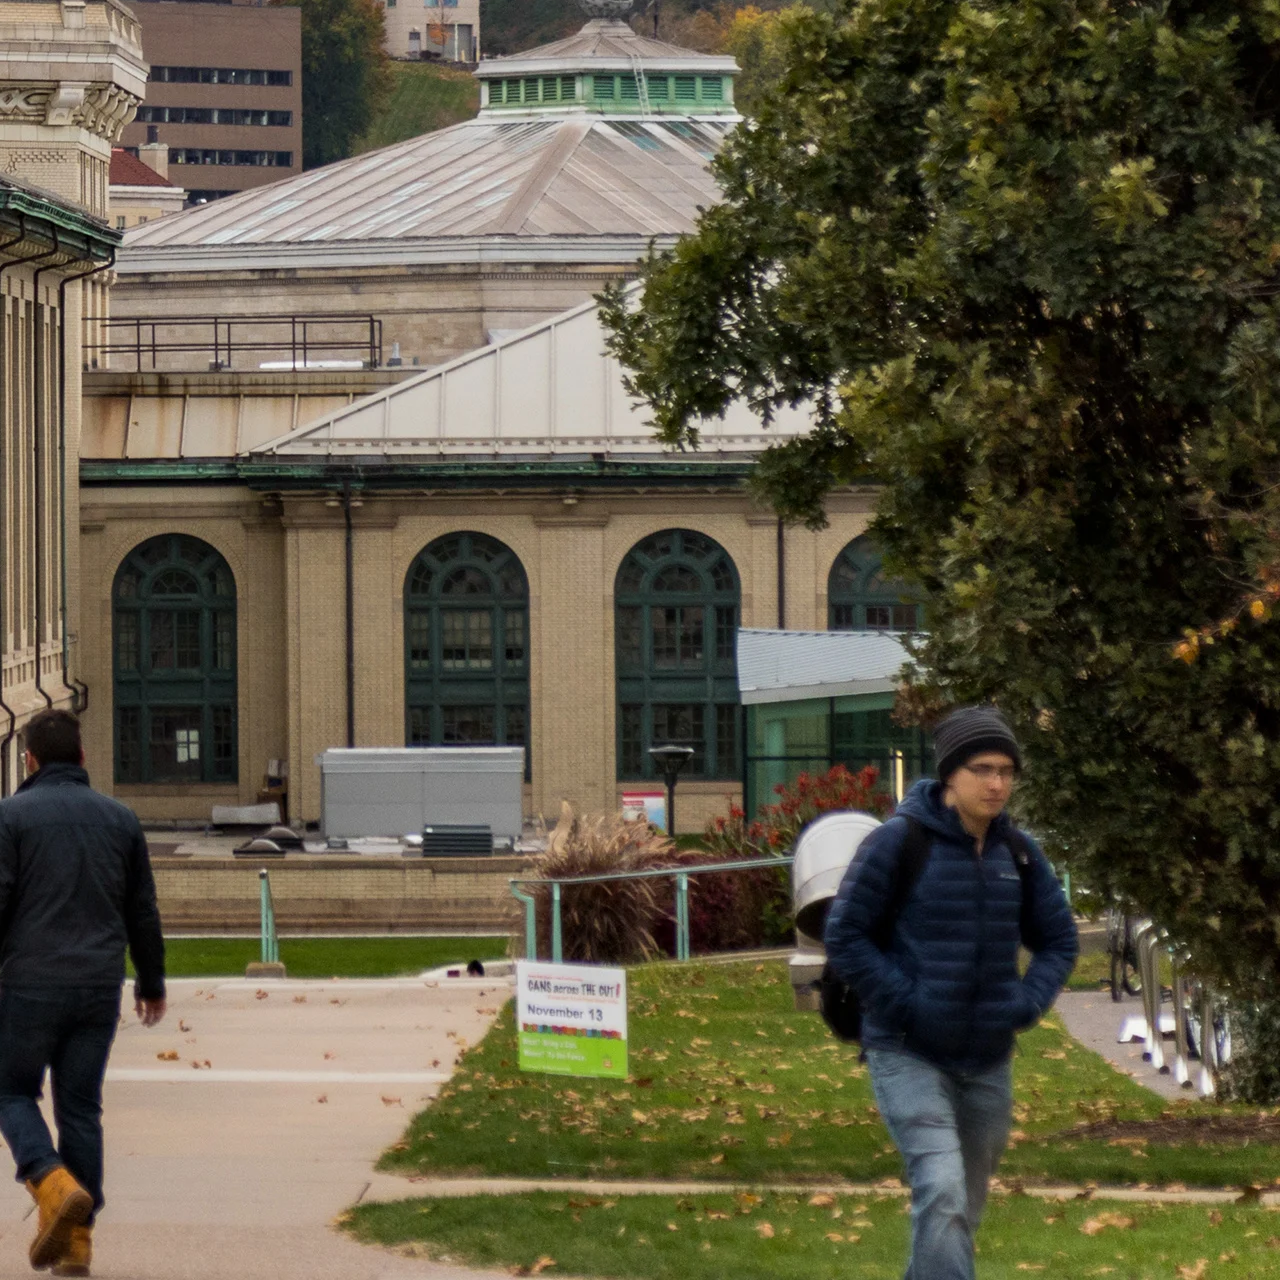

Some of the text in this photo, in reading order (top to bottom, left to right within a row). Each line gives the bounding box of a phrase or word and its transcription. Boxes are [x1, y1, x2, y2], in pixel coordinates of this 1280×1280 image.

[528, 980, 552, 994] CANS
[553, 984, 580, 995] across
[581, 984, 596, 996] THE
[528, 1004, 603, 1022] November 13
